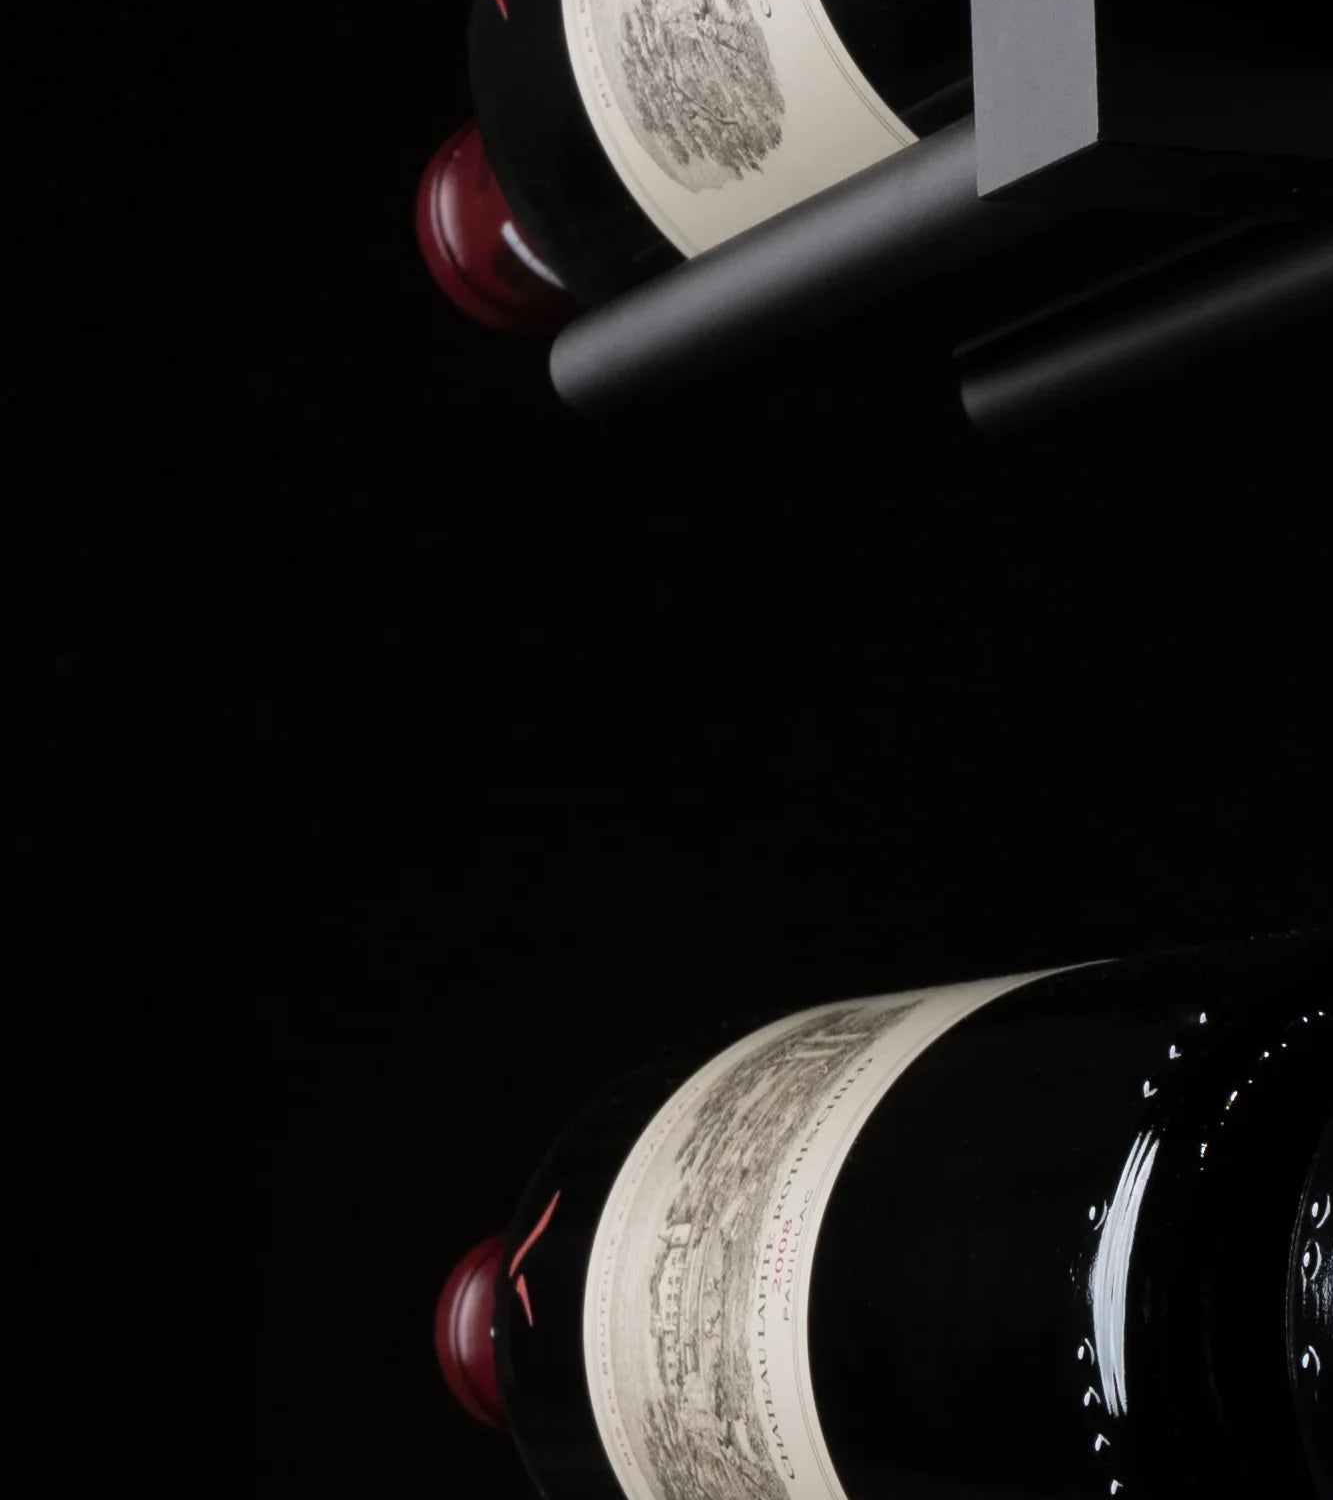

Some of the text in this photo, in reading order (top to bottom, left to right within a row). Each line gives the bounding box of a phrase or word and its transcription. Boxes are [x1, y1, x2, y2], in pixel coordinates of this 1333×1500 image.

[756, 1057, 873, 1480] CHATEAU LAFITE ROTHSCHILD
[771, 1218, 793, 1295] 2008
[782, 1188, 814, 1322] PAUILLAC
